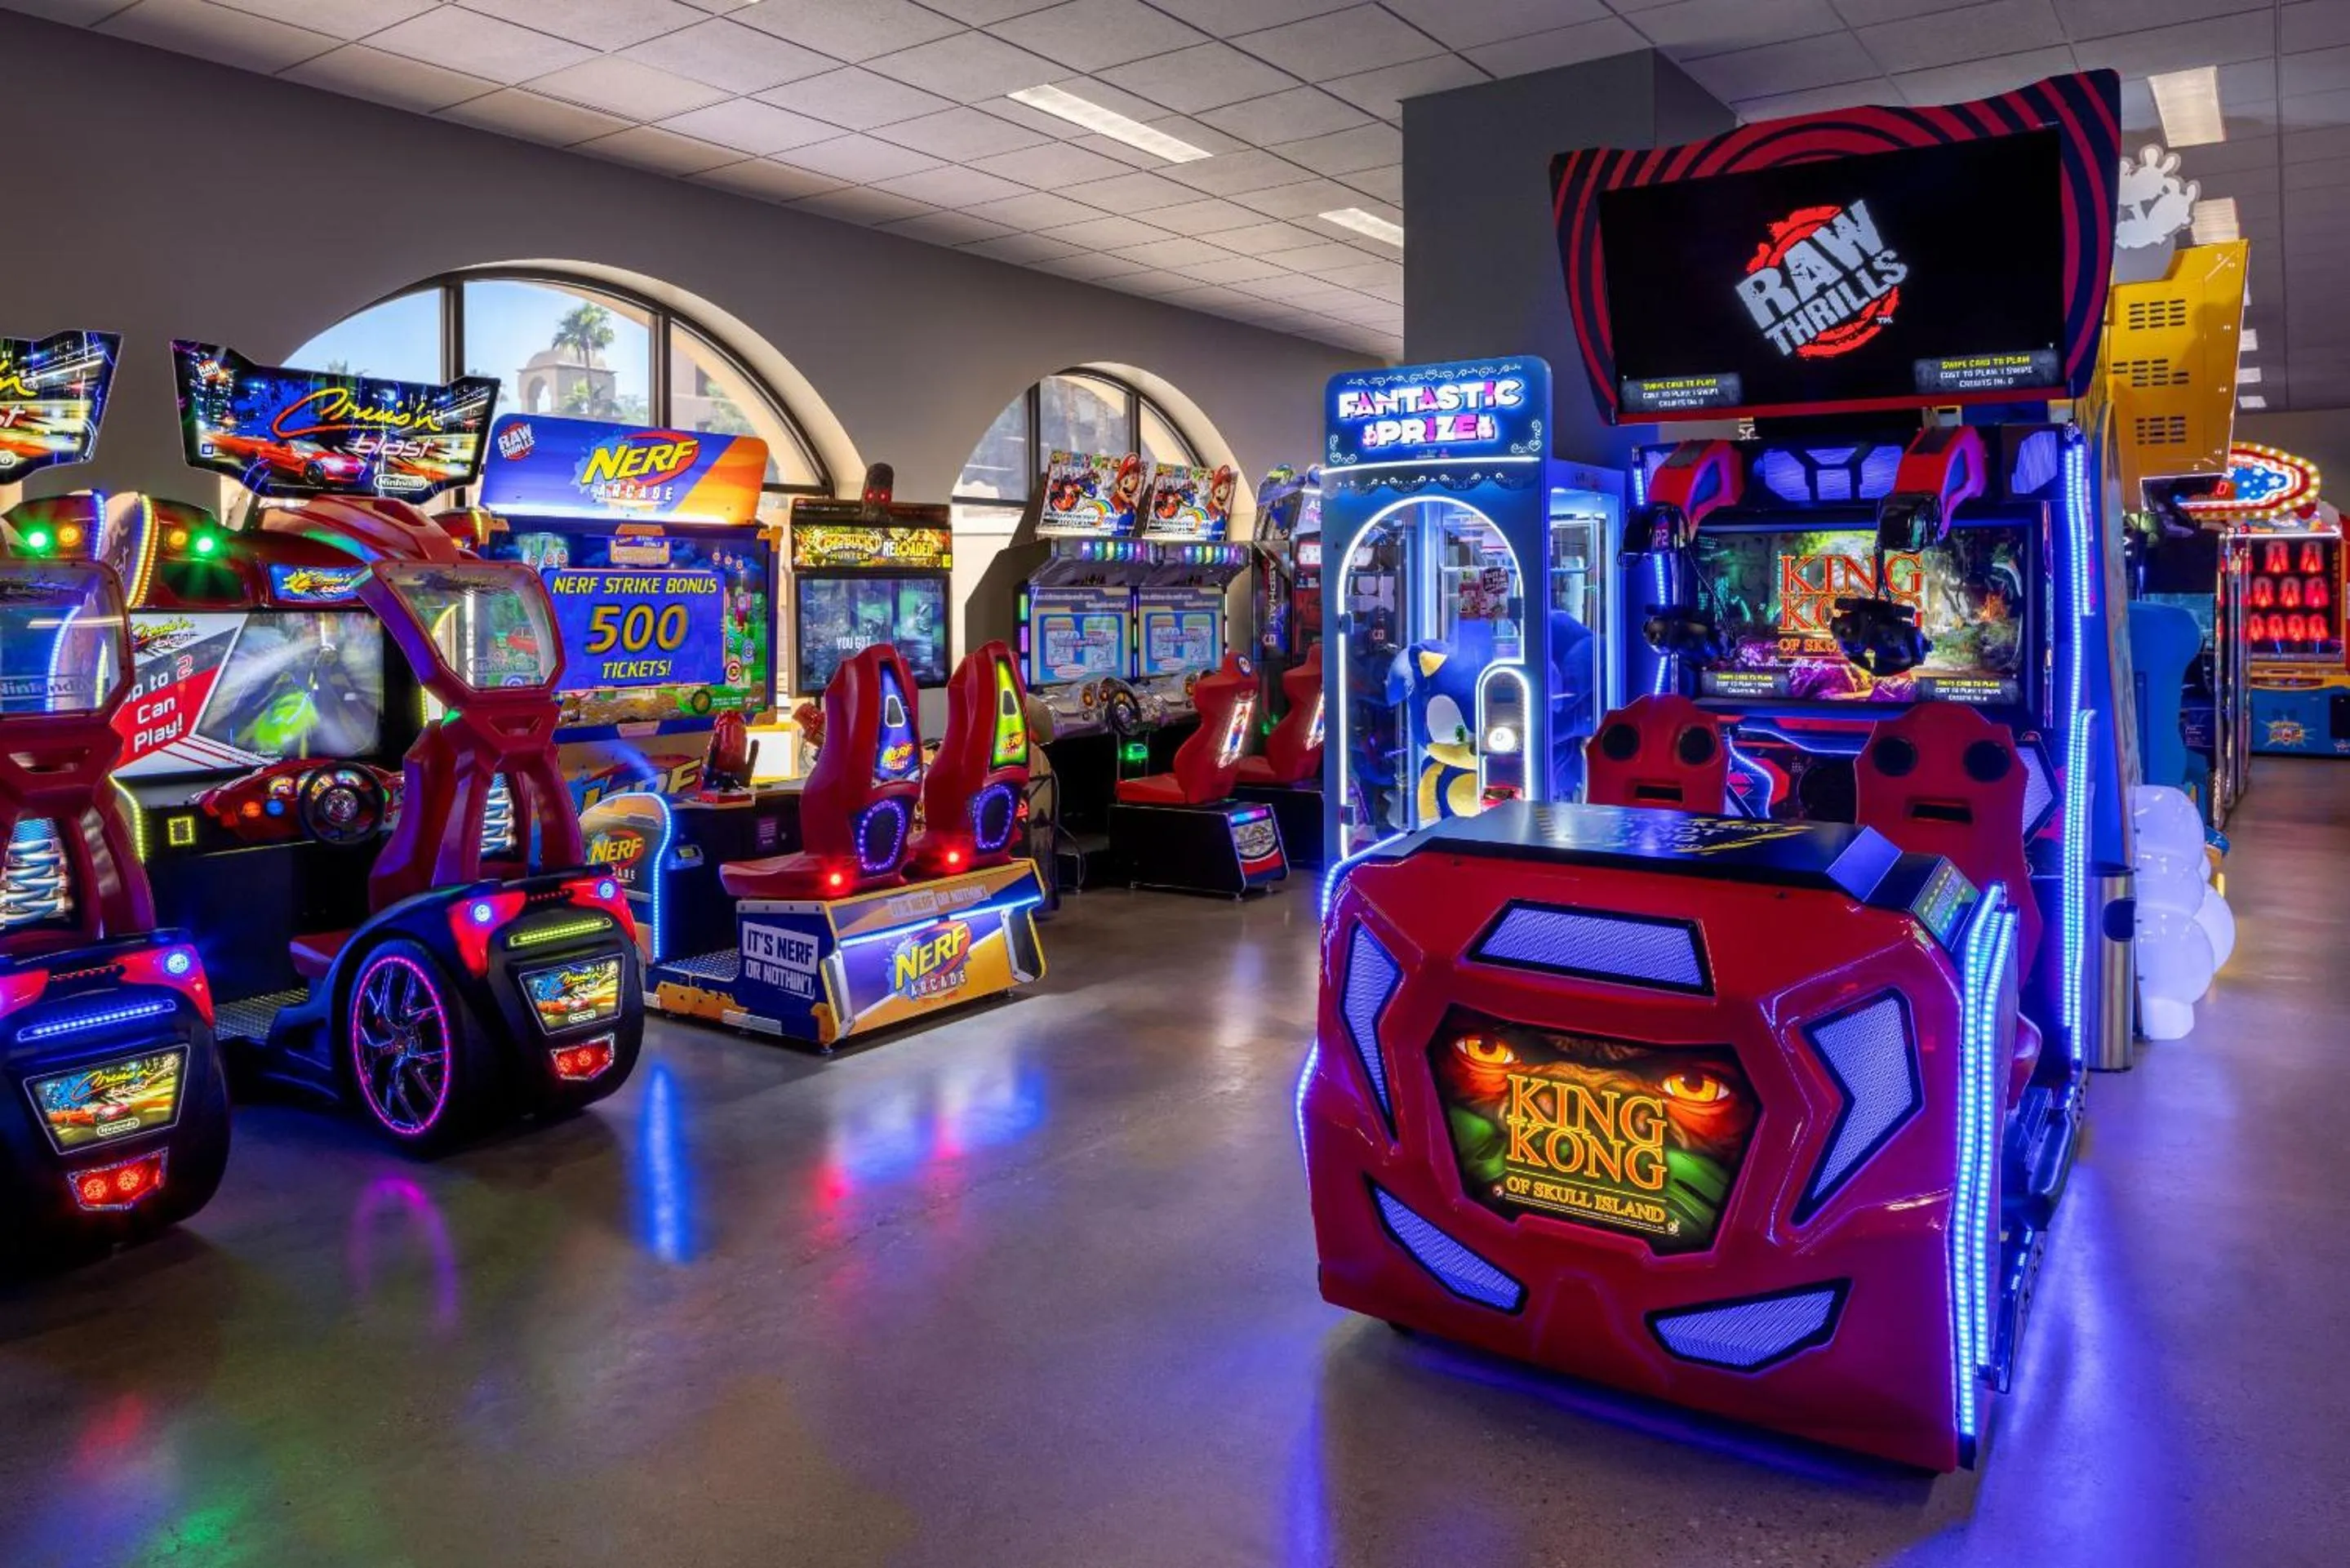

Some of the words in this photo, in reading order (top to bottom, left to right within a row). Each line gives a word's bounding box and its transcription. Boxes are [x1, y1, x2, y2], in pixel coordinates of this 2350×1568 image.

[1735, 199, 1885, 328] RAW
[1764, 249, 1908, 357] THRILLS
[1339, 380, 1523, 419] FANTASTIC
[498, 424, 532, 451] RAW
[1376, 414, 1478, 446] PRIZE
[580, 439, 699, 485] NERF
[597, 484, 673, 501] ARCADE
[883, 540, 934, 557] RELOADED
[553, 576, 597, 594] NERF
[604, 576, 660, 594] STRIKE
[666, 576, 717, 594] BONUS
[1268, 561, 1277, 624] ASPHALT
[1780, 553, 1926, 596] KING
[584, 603, 691, 655] 500
[837, 636, 853, 651] YOU
[1778, 638, 1801, 651] OF
[150, 672, 169, 691] to
[176, 654, 193, 681] 2
[602, 660, 672, 679] TICKETS!
[137, 697, 176, 725] Can
[135, 713, 183, 753] Play!
[590, 837, 643, 865] NERF
[748, 929, 773, 956] IT'S
[777, 936, 814, 966] NERF
[895, 922, 967, 990] NERF
[746, 959, 761, 980] OR
[911, 970, 966, 997] ARCADE
[1507, 1074, 1667, 1147] KING
[1507, 1117, 1667, 1191] KONG
[1507, 1177, 1531, 1194] OF
[1533, 1182, 1593, 1208] SKULL
[1595, 1194, 1666, 1222] ISLAND
